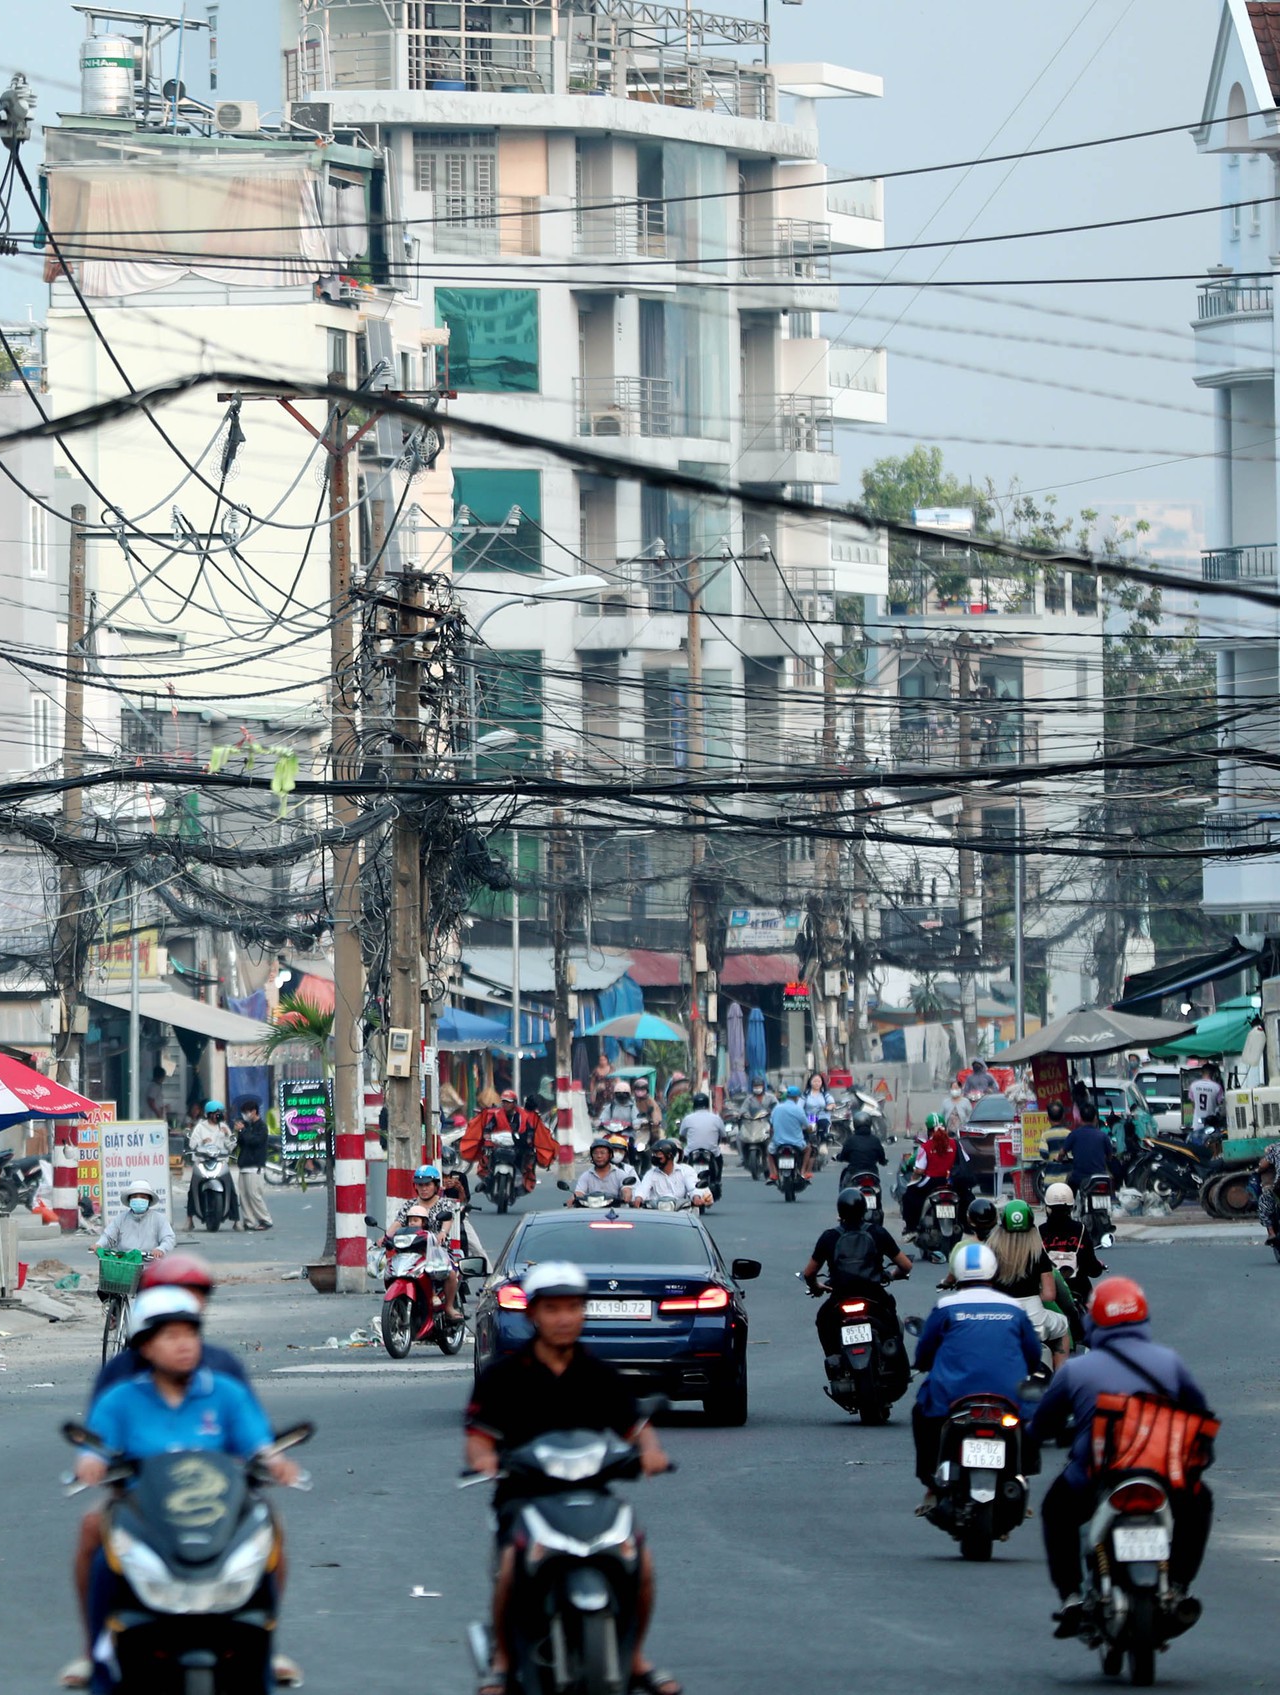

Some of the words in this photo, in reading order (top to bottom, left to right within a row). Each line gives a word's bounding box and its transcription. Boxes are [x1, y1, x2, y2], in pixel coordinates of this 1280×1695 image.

[1199, 1094, 1208, 1111] 9
[105, 1133, 125, 1151] GIẶT
[127, 1129, 144, 1147] SẤY
